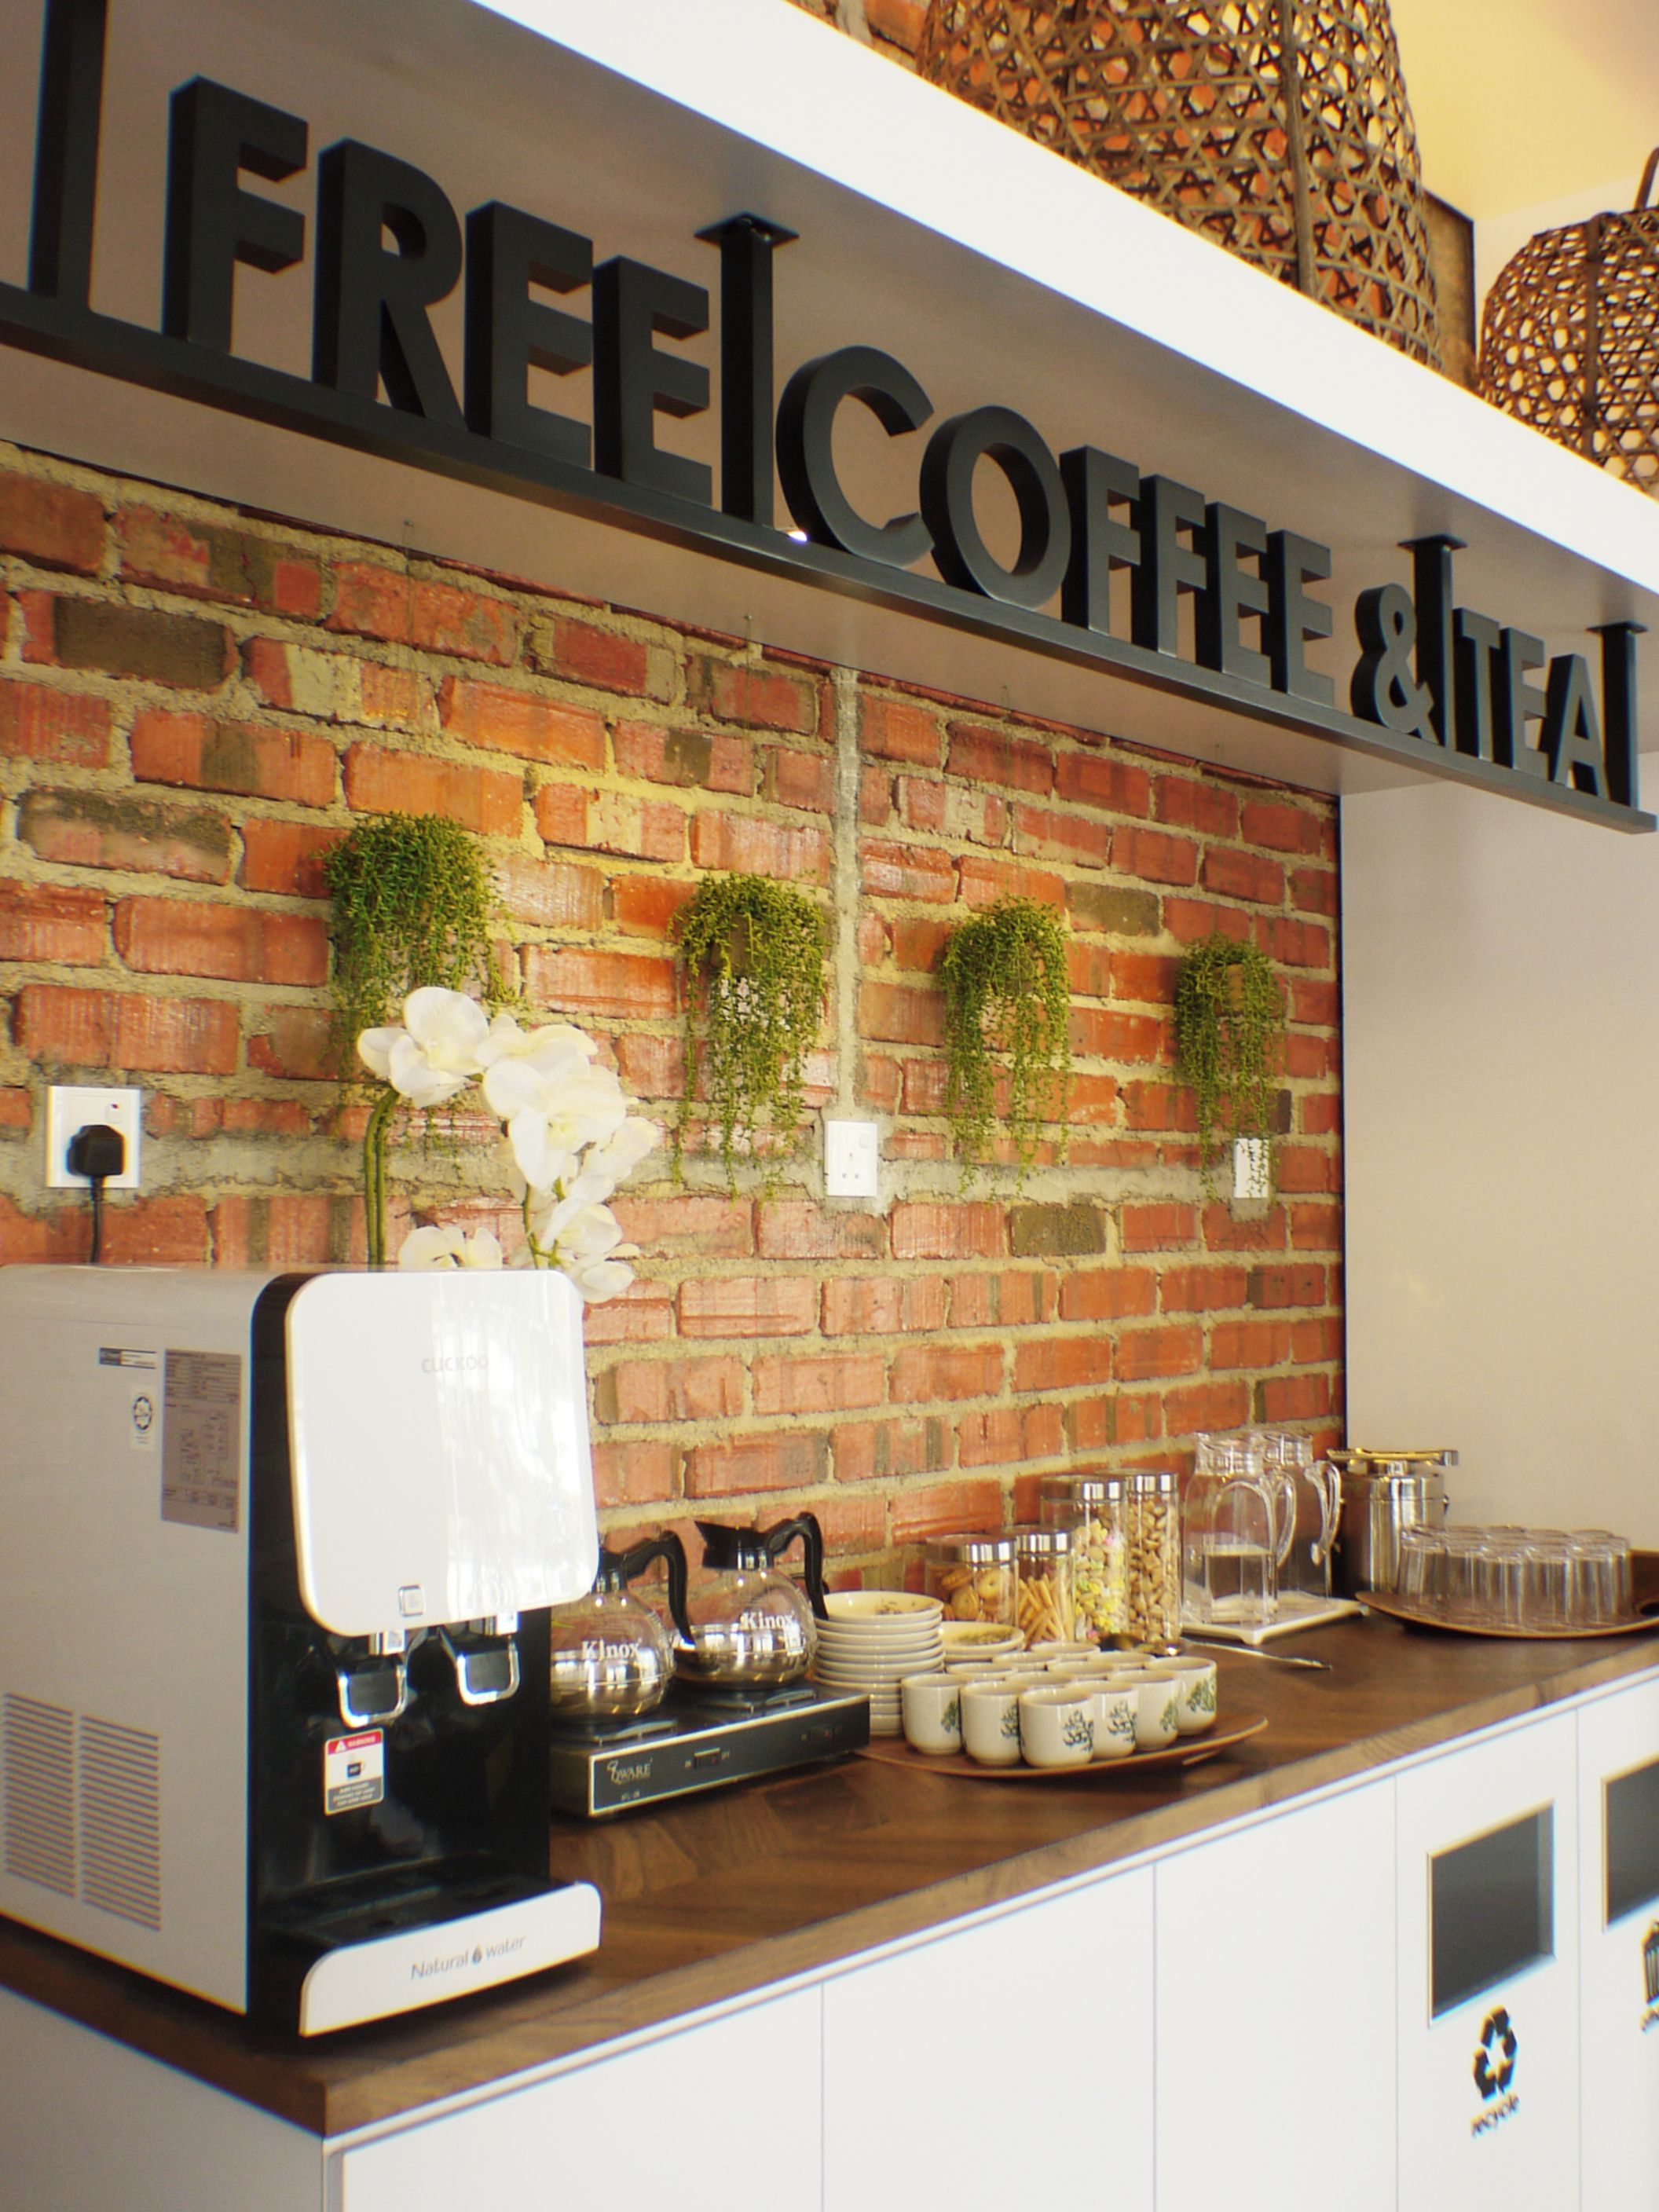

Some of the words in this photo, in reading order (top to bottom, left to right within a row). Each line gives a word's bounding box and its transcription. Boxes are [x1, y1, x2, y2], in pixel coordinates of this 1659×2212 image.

[160, 75, 712, 510] FREE
[775, 346, 1335, 707] COFFEE
[1351, 583, 1435, 740] &
[1452, 608, 1605, 797] TEA
[421, 1355, 489, 1374] CUCKOO
[742, 1610, 795, 1629] Kinox
[580, 1639, 639, 1662] Kinox
[411, 1950, 469, 1980] Natural
[485, 1936, 526, 1960] water
